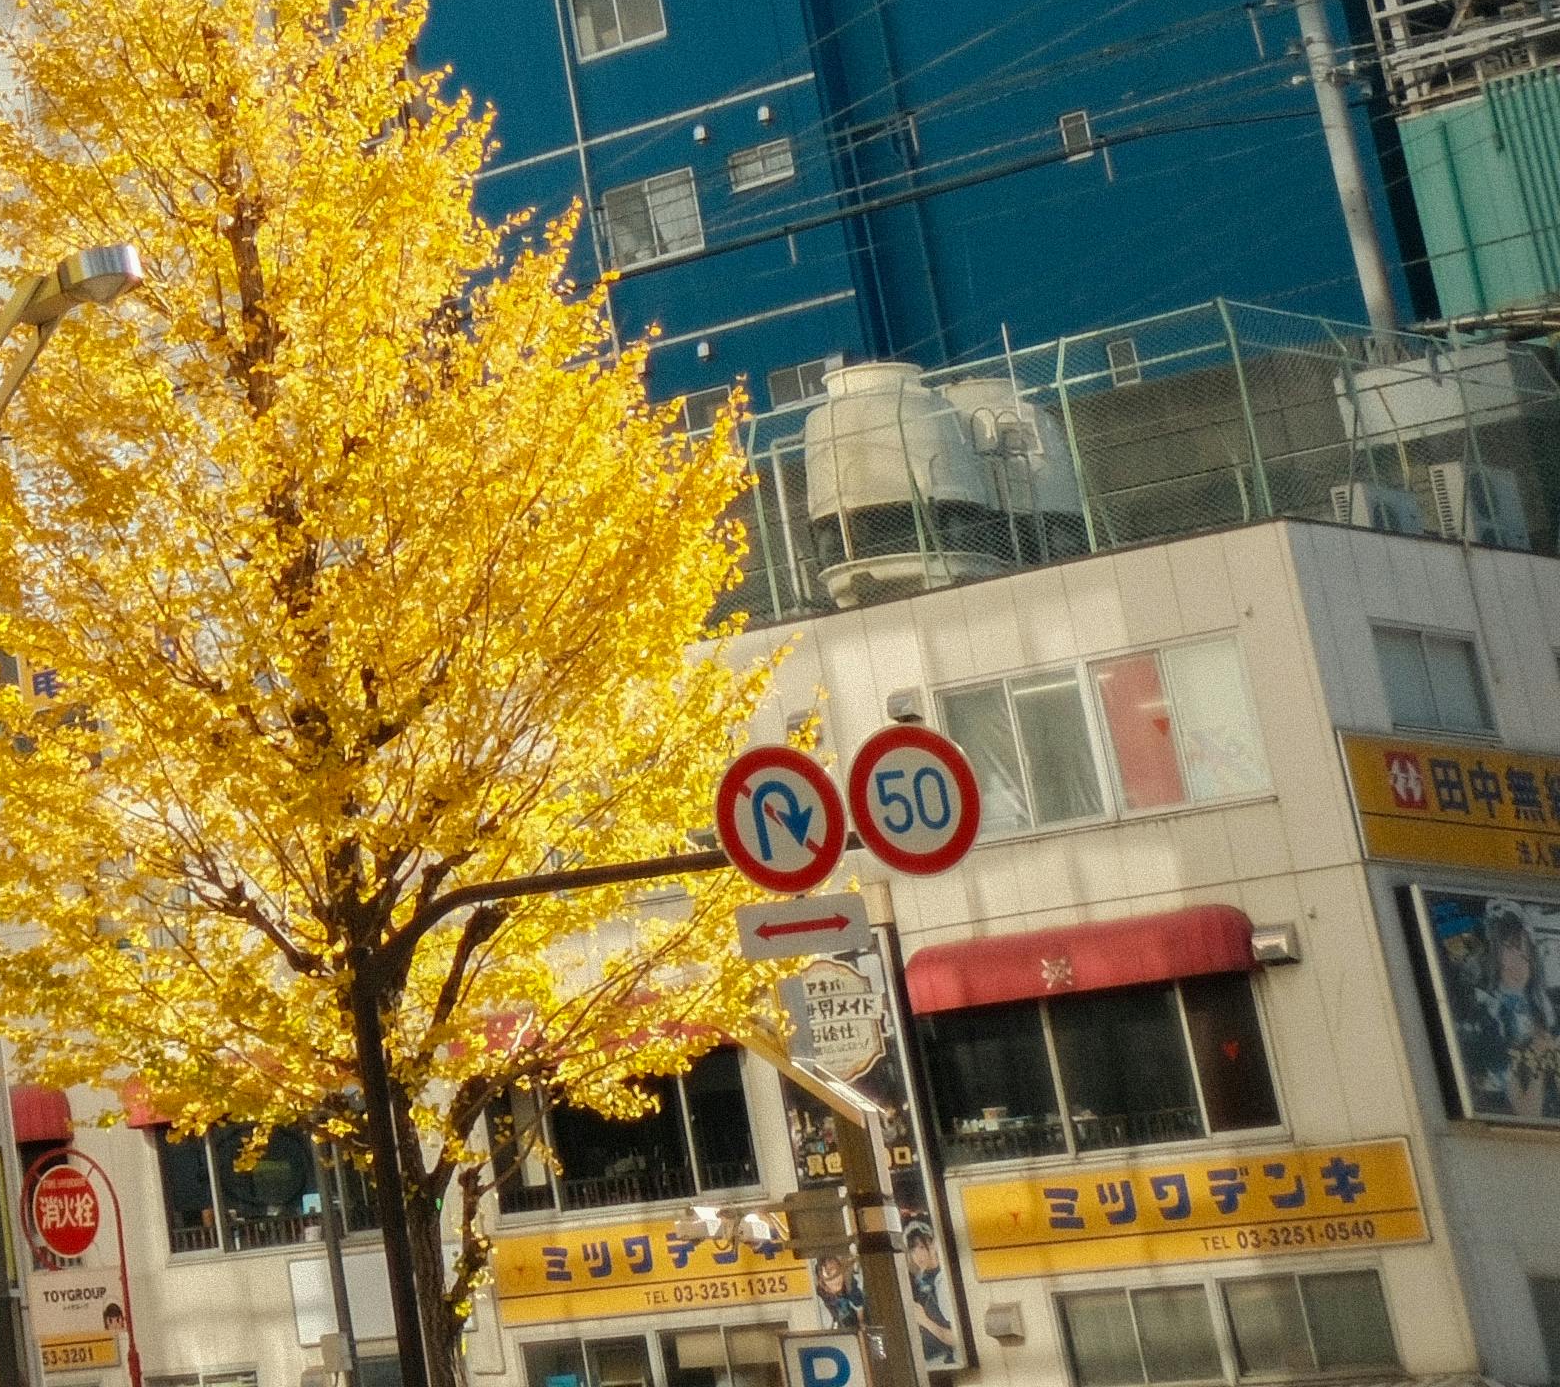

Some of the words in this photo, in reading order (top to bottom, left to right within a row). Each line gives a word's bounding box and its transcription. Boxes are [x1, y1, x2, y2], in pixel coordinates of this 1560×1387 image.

[873, 765, 951, 836] 50
[39, 1192, 96, 1229] 消火栓
[1201, 1231, 1233, 1253] TEL
[42, 1286, 108, 1303] TOYGROUP
[644, 1290, 669, 1306] TEL
[673, 1275, 789, 1304] 03-3251-1325
